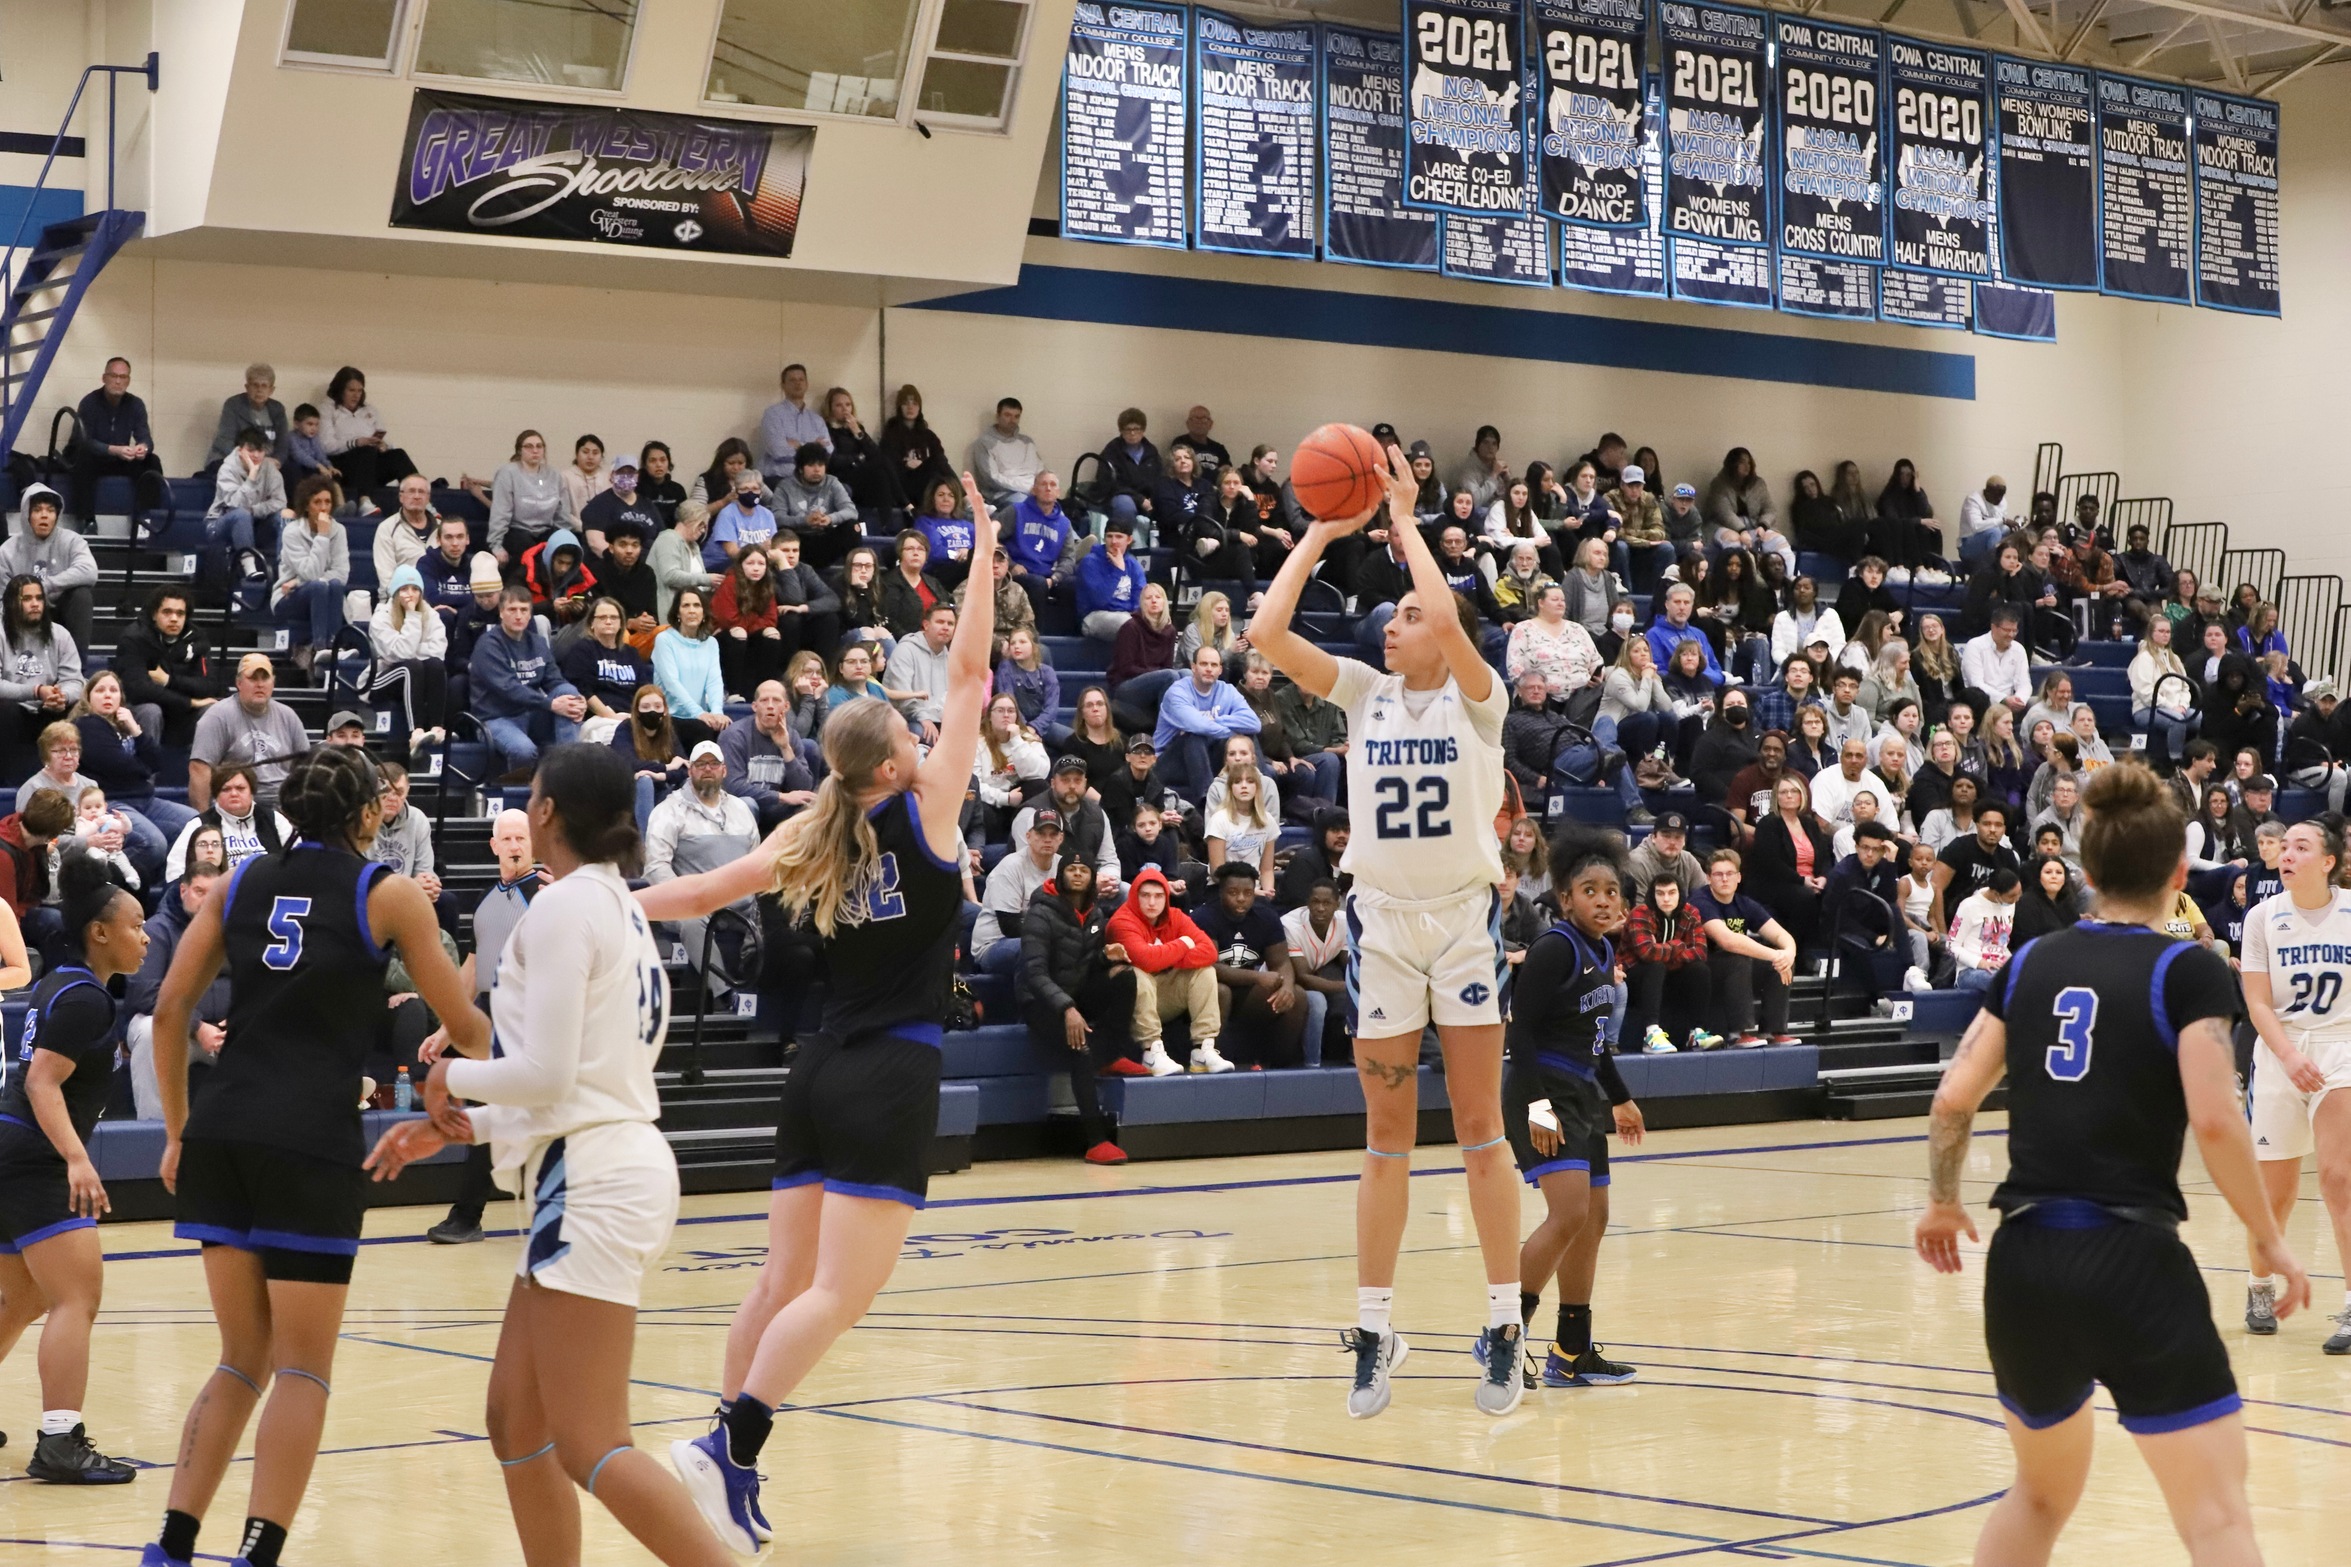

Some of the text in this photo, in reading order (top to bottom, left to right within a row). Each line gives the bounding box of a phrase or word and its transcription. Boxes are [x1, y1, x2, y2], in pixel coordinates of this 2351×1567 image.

[1471, 0, 1511, 11] COLLEGE
[1109, 6, 1183, 35] CENTRAL
[1200, 17, 1312, 51] IOWA CENTRAL
[1545, 9, 1635, 32] COMMUNITY COLLEGE
[1661, 2, 1764, 39] IOWA CENTRAL
[1074, 25, 1176, 46] COMMUNITY COLLEGE
[1326, 32, 1364, 58] IOWA
[1417, 11, 1512, 72] 2021
[1669, 29, 1757, 50] COMMUNITY COLLEGE
[1779, 23, 1878, 58] IOWA CENTRAL
[1104, 42, 1146, 62] MENS
[1208, 43, 1305, 62] COMMUNITY COLLEGE
[1335, 58, 1385, 72] COMMUNITY
[1546, 30, 1638, 89] 2021
[1786, 48, 1871, 69] COMMUNITY COLLEGE
[1891, 44, 1985, 78] IOWA CENTRAL
[1068, 52, 1181, 88] INDOOR TRACK
[1235, 60, 1276, 78] MENS
[1362, 74, 1401, 92] MENS
[1674, 50, 1758, 107] 2021
[1898, 69, 1979, 89] COMMUNITY COLLEGE
[1997, 61, 2089, 94] IOWA CENTRAL
[1068, 76, 1182, 103] NATIONAL CHAMPIONS
[1202, 69, 1313, 101] INDOOR TRACK
[1329, 83, 1382, 112] INDOOR
[1443, 75, 1486, 102] NCA
[1787, 68, 1874, 126] 2020
[2004, 86, 2083, 105] COMMUNITY COLLEGE
[2100, 79, 2185, 113] IOWA CENTRAL
[1203, 92, 1312, 115] NATIONAL CHAMPIONS
[1329, 105, 1377, 125] NATIONAL
[1423, 95, 1513, 128] NATIONAL
[1571, 93, 1614, 119] NDA
[1898, 87, 1981, 145] 2020
[2000, 97, 2089, 123] MENS/WOMENS
[2105, 103, 2180, 123] COMMUNITY COLLEGE
[2195, 96, 2276, 130] IOWA CENTRAL
[1410, 119, 1521, 153] CHAMPIONS
[1558, 116, 1638, 144] NATIONAL
[1688, 108, 1745, 138] NJCAA
[2018, 114, 2072, 142] BOWLING
[2127, 119, 2158, 137] MENS
[2201, 119, 2270, 140] COMMUNITY COLLEGE
[1543, 132, 1644, 168] CHAMPIONS
[1673, 132, 1759, 163] NATIONAL
[1803, 126, 1860, 154] NJCAA
[2002, 133, 2042, 150] NATIONAL
[2042, 139, 2090, 157] CHAMPIONS
[2103, 127, 2186, 161] OUTDOOR TRACK
[2217, 134, 2256, 154] WOMENS
[411, 109, 773, 206] GREAT WESTERN
[1669, 155, 1763, 187] CHAMPIONS
[1791, 149, 1870, 180] NATIONAL
[1914, 144, 1967, 172] NJCAA
[2104, 148, 2141, 167] NATIONAL
[2141, 156, 2187, 174] CHAMPIONS
[2197, 143, 2276, 177] INDOOR TRACK
[1424, 161, 1511, 185] LARGE CO-ED
[1785, 170, 1881, 204] CHAMPIONS
[1905, 165, 1978, 197] NATIONAL
[2199, 165, 2277, 190] NATIONAL CHAMPIONS
[467, 149, 743, 227] Shootout
[1410, 175, 1524, 210] CHEERLEADING
[1596, 182, 1627, 199] HOP
[613, 196, 700, 213] SPONSORED BY:
[1558, 193, 1634, 222] DANCE
[1688, 195, 1750, 216] WOMENS
[1895, 188, 1987, 221] CHAMPIONS
[1674, 206, 1761, 241] BOWLING
[1816, 212, 1852, 231] MENS
[1785, 224, 1882, 258] CROSS COUNTRY
[1926, 229, 1961, 248] MENS
[1895, 241, 1987, 275] HALF MARATHON
[1365, 736, 1459, 766] TRITONS
[1375, 776, 1452, 839] 22
[262, 896, 312, 971] 5
[2277, 944, 2351, 967] TRITONS
[2284, 971, 2343, 1015] 20
[2045, 986, 2099, 1083] 3
[681, 1228, 1074, 1260] COT
